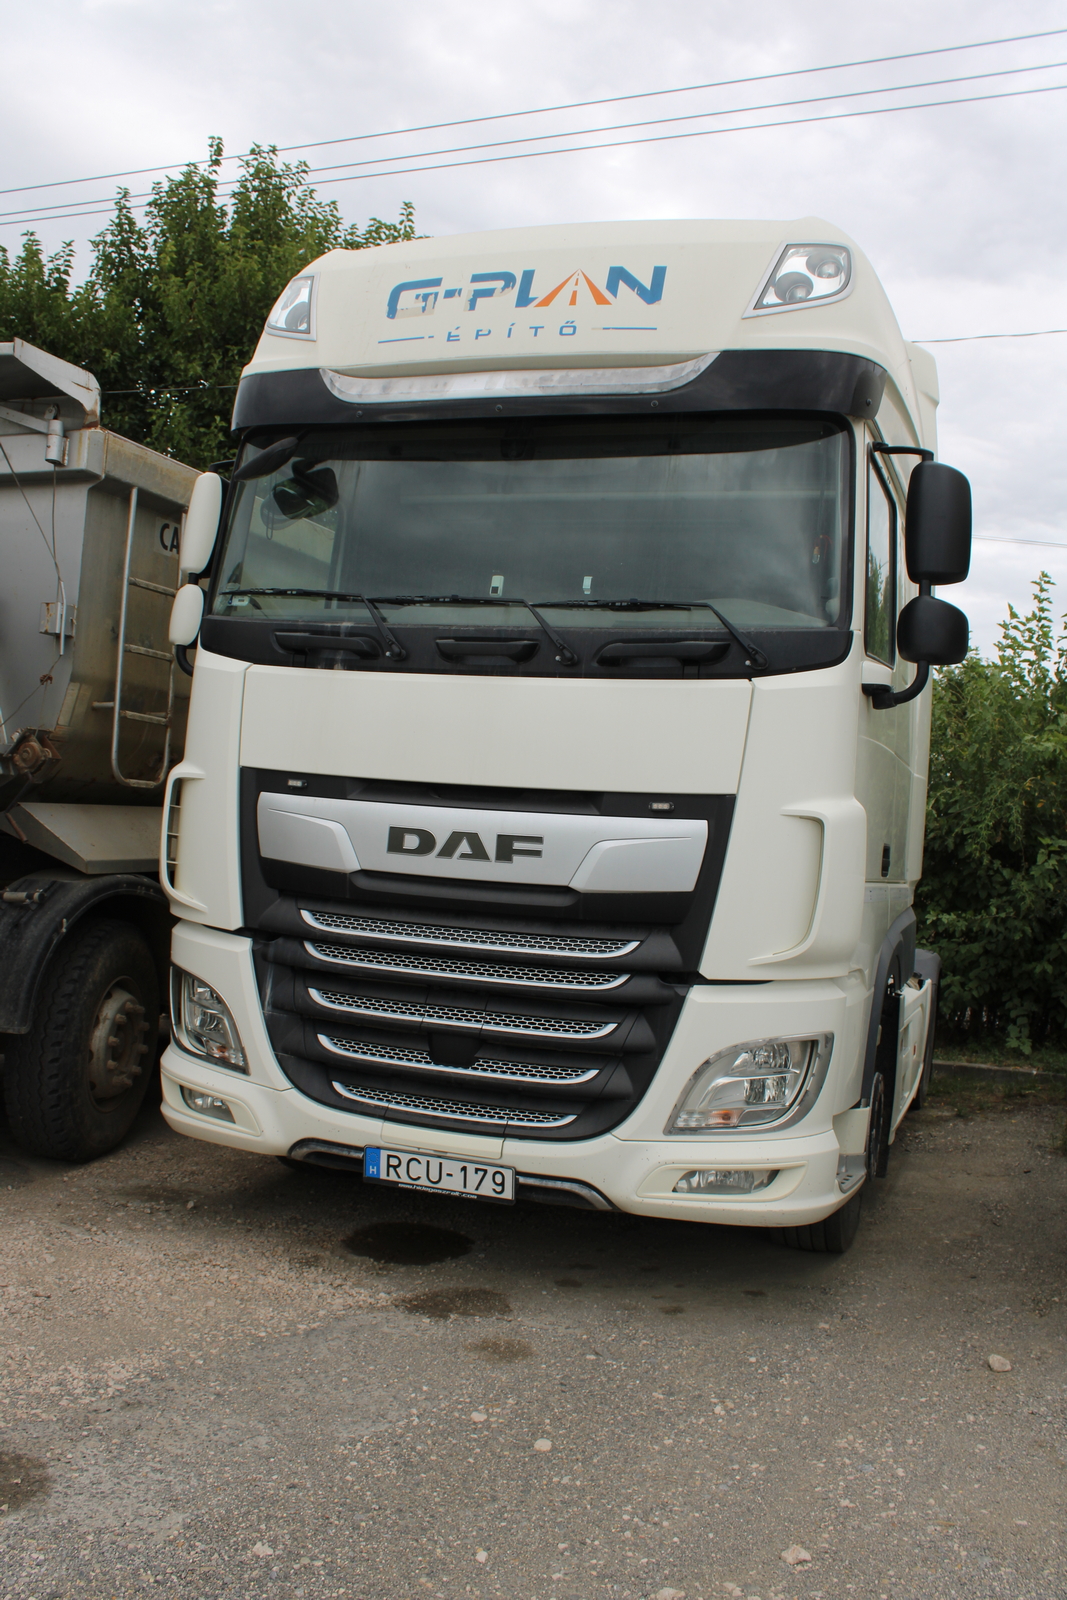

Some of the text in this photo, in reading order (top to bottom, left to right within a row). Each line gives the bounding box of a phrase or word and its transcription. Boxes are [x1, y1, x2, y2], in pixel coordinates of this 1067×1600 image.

[386, 265, 667, 320] G-PLAN
[446, 320, 577, 342] ÉPÍTŐ
[386, 825, 544, 864] DAF
[369, 1153, 506, 1195] H RCU-179
